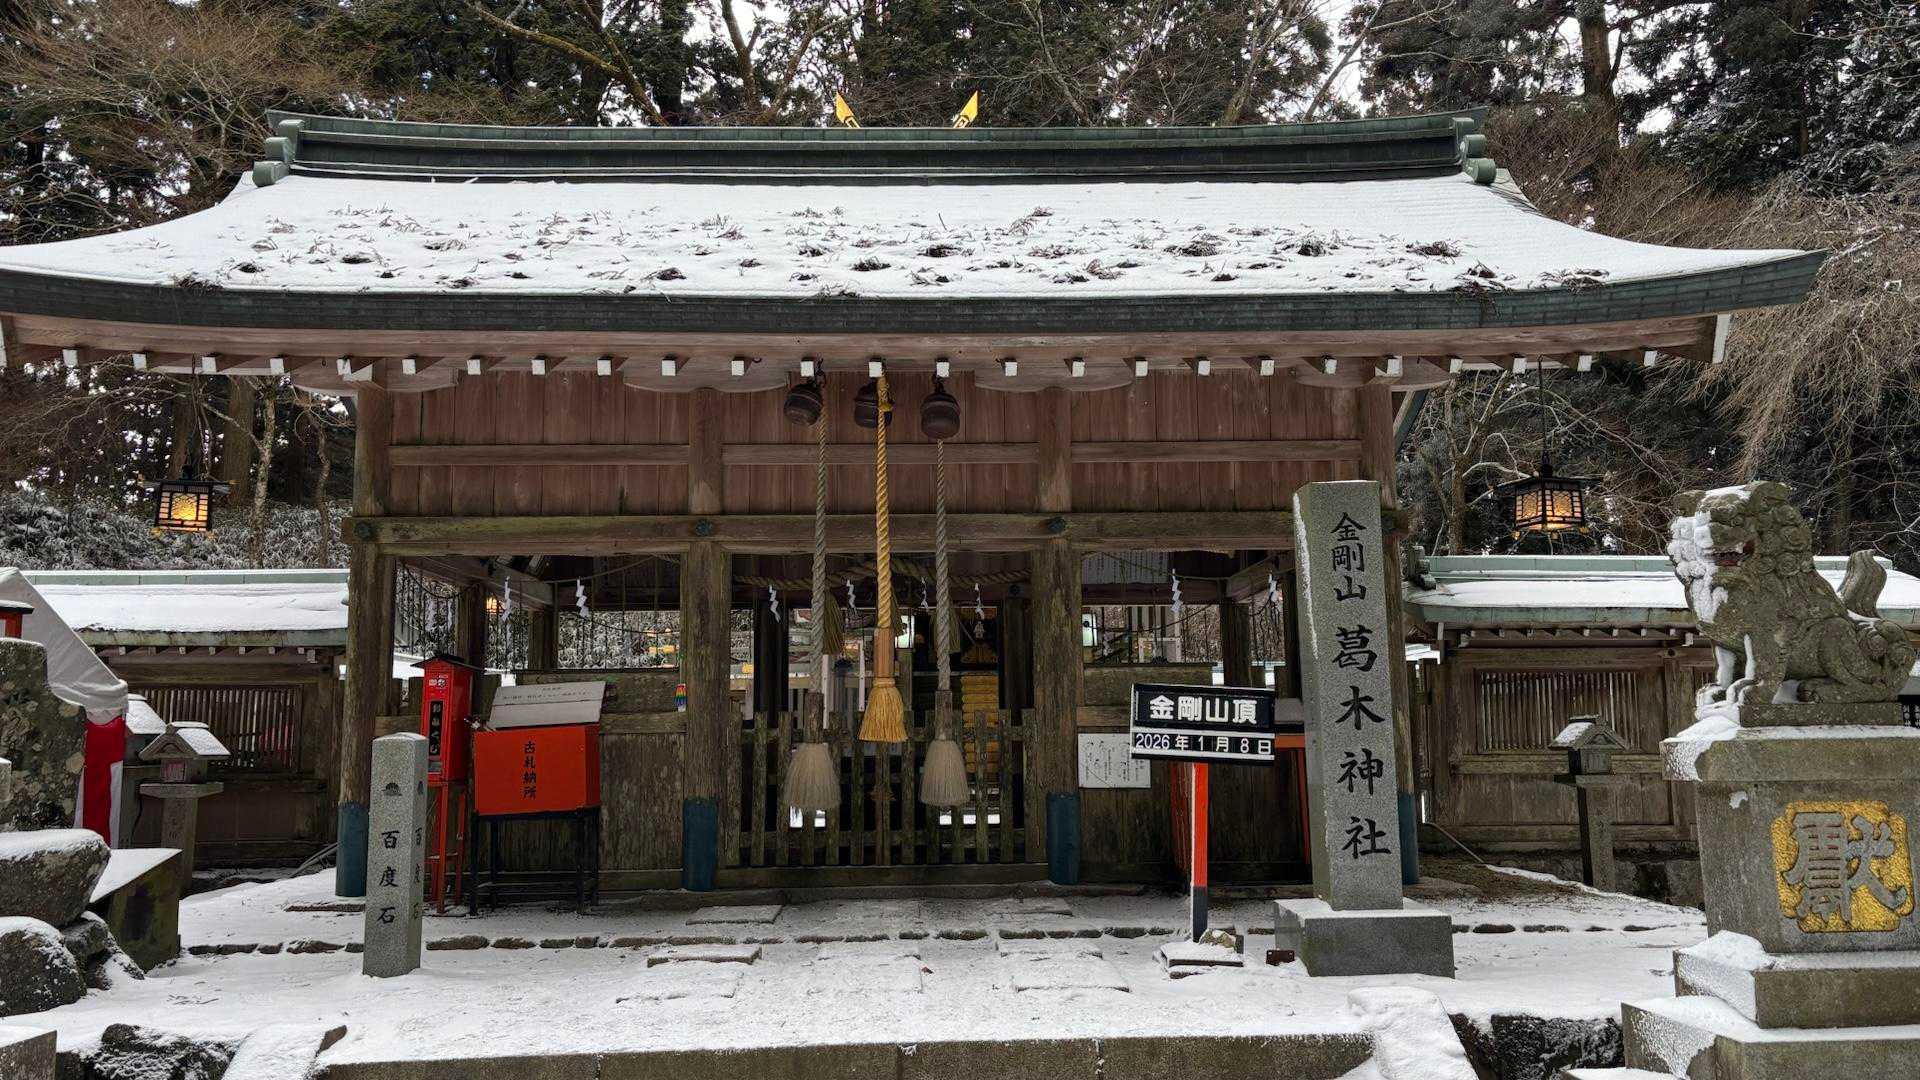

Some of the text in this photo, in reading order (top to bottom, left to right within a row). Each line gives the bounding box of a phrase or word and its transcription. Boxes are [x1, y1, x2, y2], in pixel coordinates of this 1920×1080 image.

[1149, 694, 1258, 725] 金剛山頂
[1330, 511, 1393, 860] 金剛山葛木神社
[523, 740, 537, 800] 古札納所
[377, 829, 400, 925] 百度石
